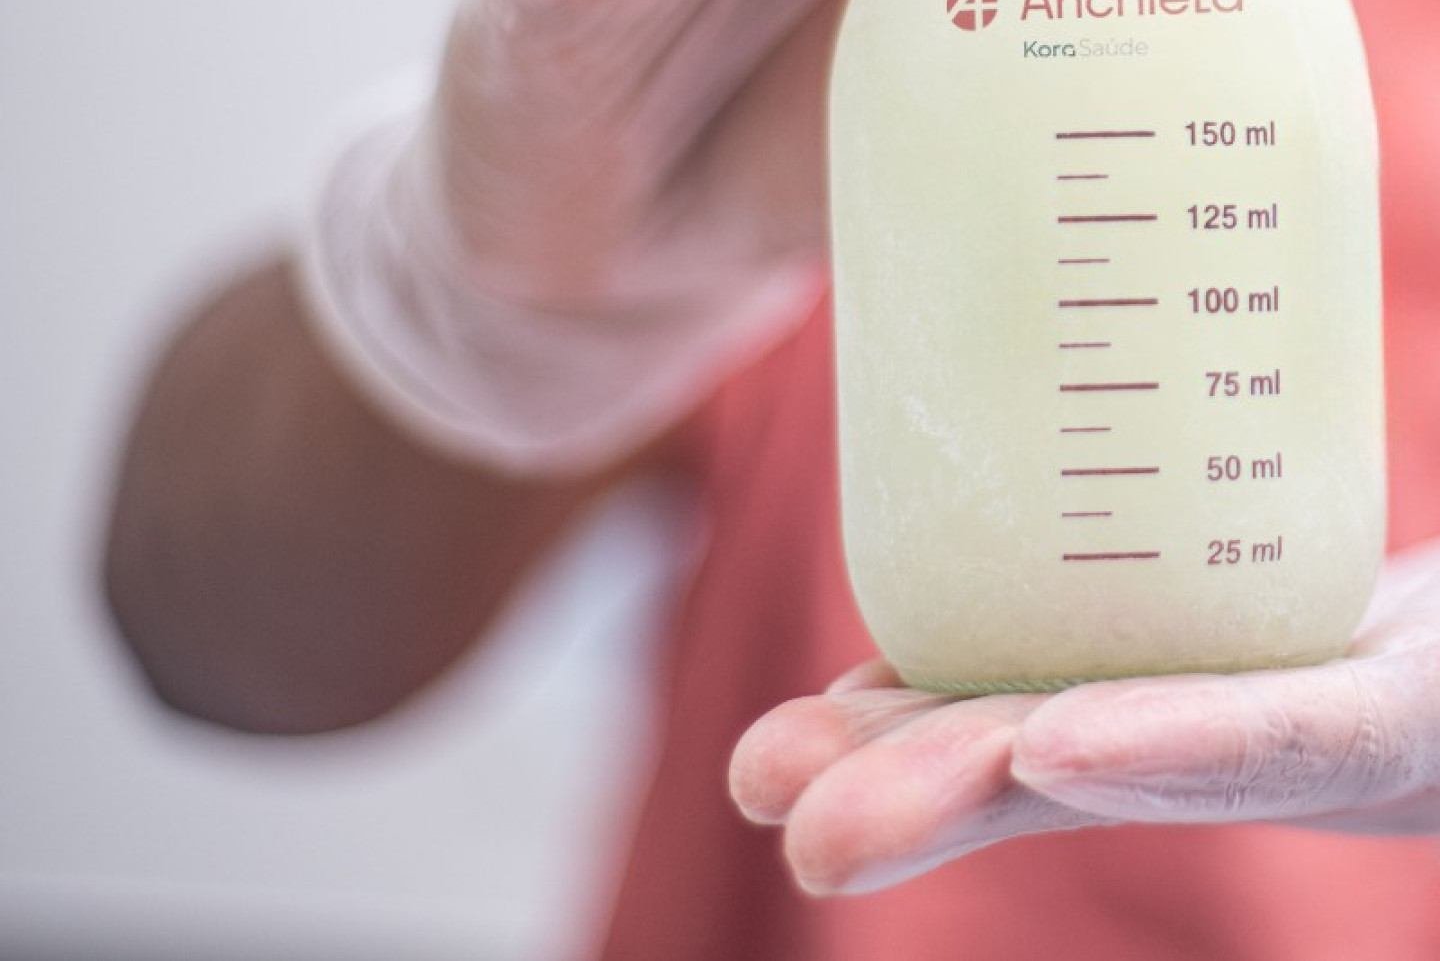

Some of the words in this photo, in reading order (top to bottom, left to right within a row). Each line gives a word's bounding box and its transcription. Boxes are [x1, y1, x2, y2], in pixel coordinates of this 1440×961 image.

[1023, 40, 1076, 58] Kora
[1184, 120, 1236, 147] 150
[1245, 119, 1276, 147] ml
[1185, 203, 1238, 230] 125
[1246, 202, 1278, 230] ml
[1187, 286, 1240, 315] 100
[1248, 285, 1279, 313] ml
[1204, 371, 1241, 397] 75
[1249, 368, 1281, 397] ml
[1206, 454, 1242, 482] 50
[1251, 451, 1283, 480] ml
[1206, 539, 1242, 566] 25
[1251, 535, 1283, 563] ml
